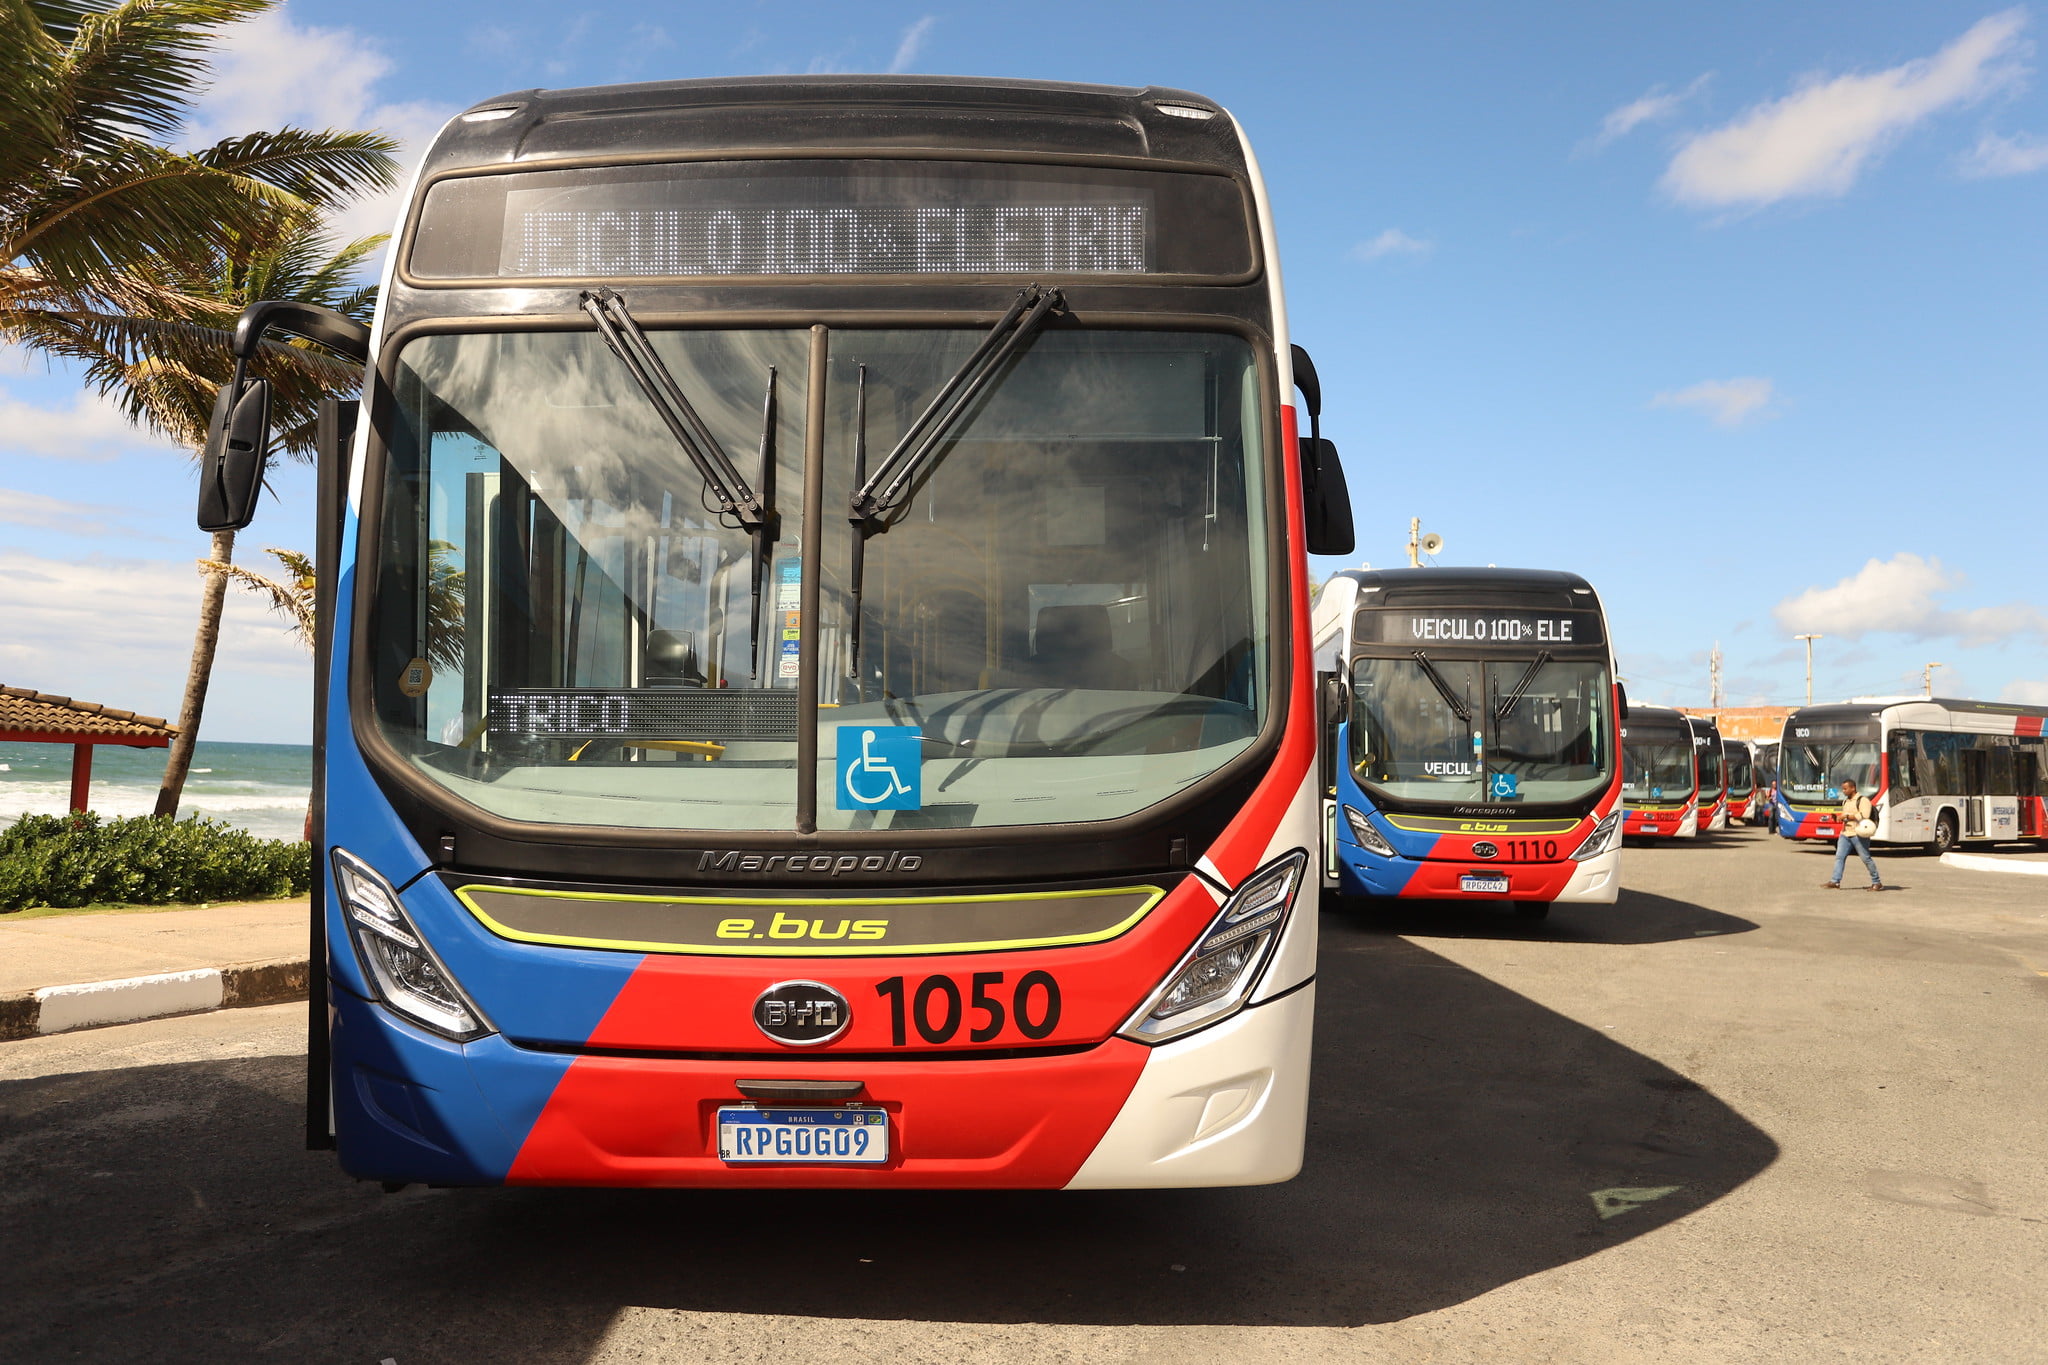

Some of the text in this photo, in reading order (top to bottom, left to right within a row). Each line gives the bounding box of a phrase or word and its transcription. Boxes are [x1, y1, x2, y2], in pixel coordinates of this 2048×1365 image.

[1412, 618, 1573, 641] VEICULO 100% ELE
[1424, 762, 1472, 775] VEICUL
[1453, 806, 1517, 815] Marcopolo
[1460, 822, 1508, 832] e.bus
[1507, 840, 1557, 860] 1110
[697, 851, 923, 877] Marcopolo
[1465, 881, 1503, 891] RPG2C42
[716, 912, 889, 940] e.bus
[763, 1000, 838, 1026] BYD
[875, 970, 1062, 1047] 1050
[736, 1127, 869, 1156] RPG0G09
[721, 1149, 731, 1159] BR
